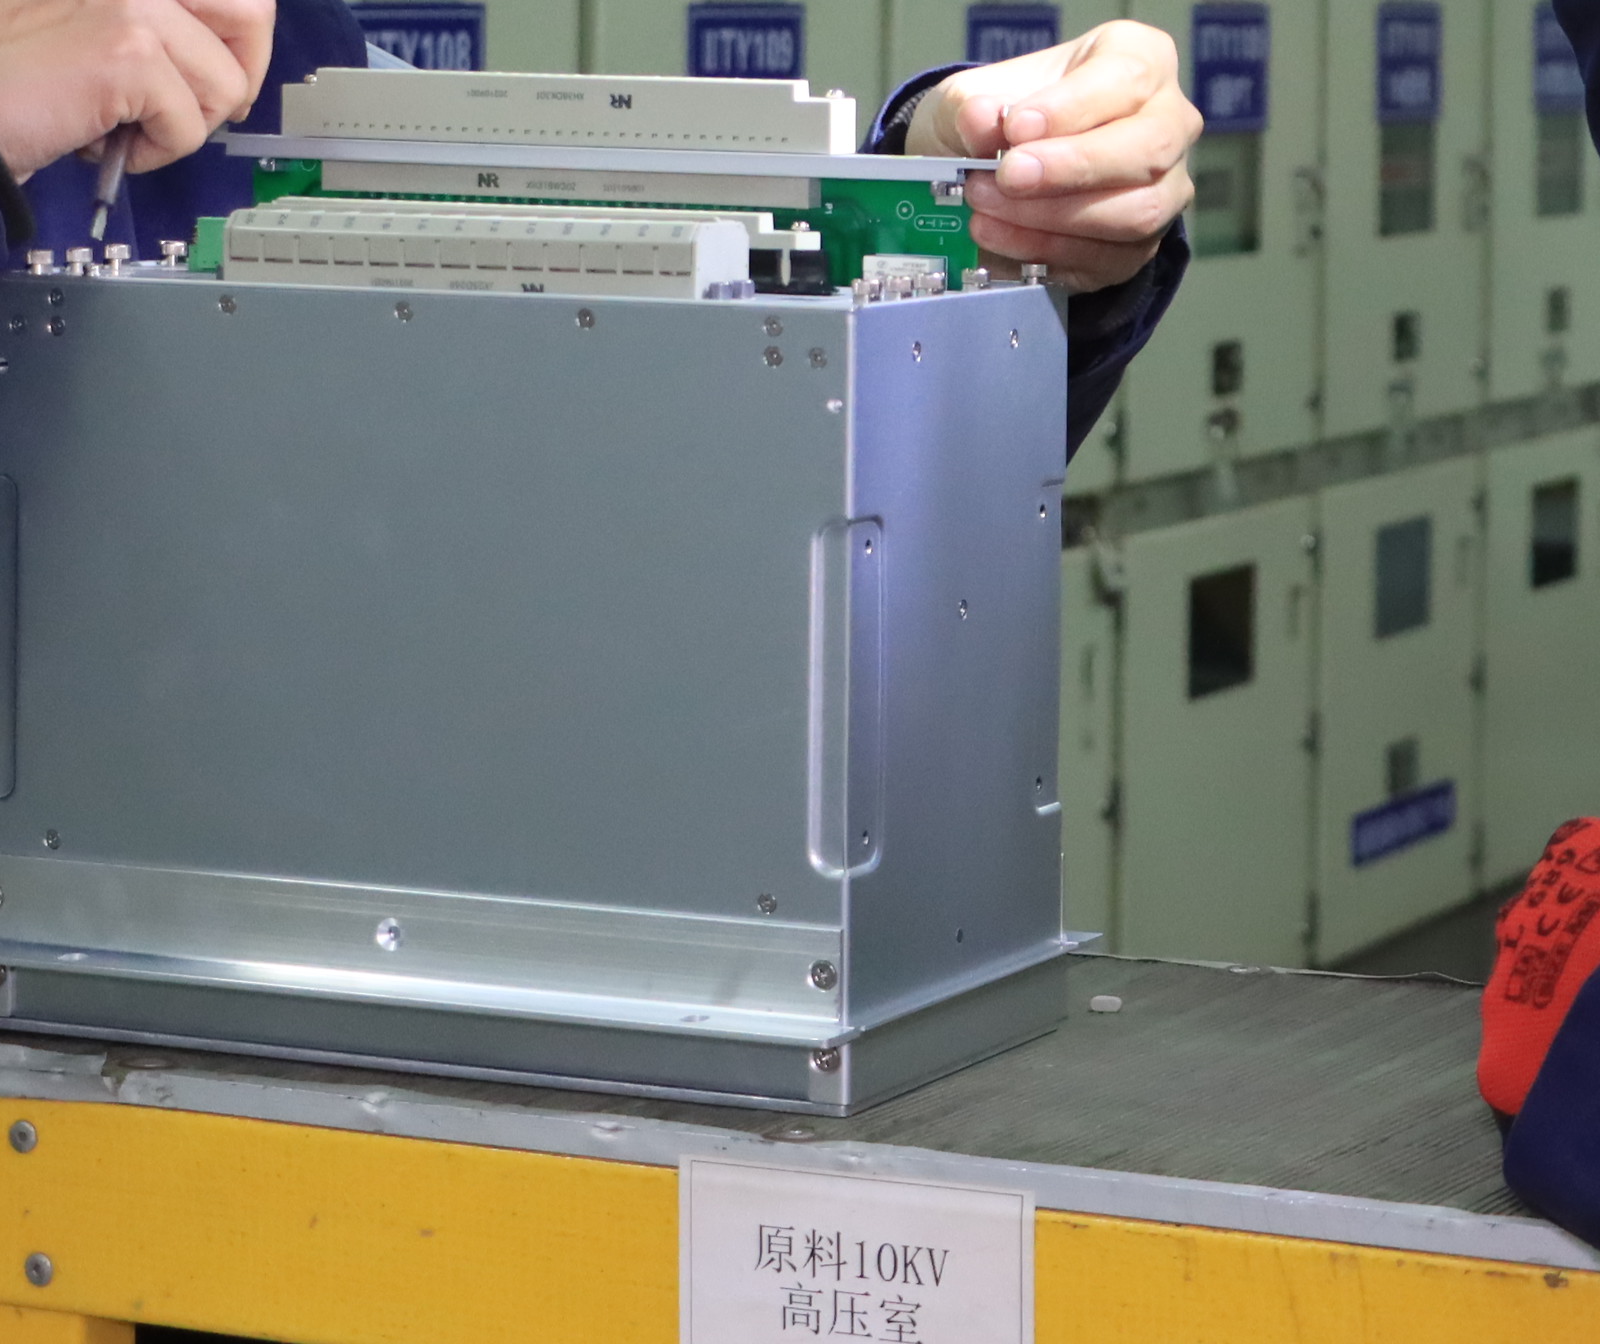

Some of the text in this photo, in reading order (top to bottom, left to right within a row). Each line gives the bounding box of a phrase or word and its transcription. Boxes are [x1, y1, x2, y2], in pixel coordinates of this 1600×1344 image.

[477, 172, 500, 189] NR
[754, 1223, 950, 1287] 原料10KV
[779, 1282, 924, 1344] 高压室
